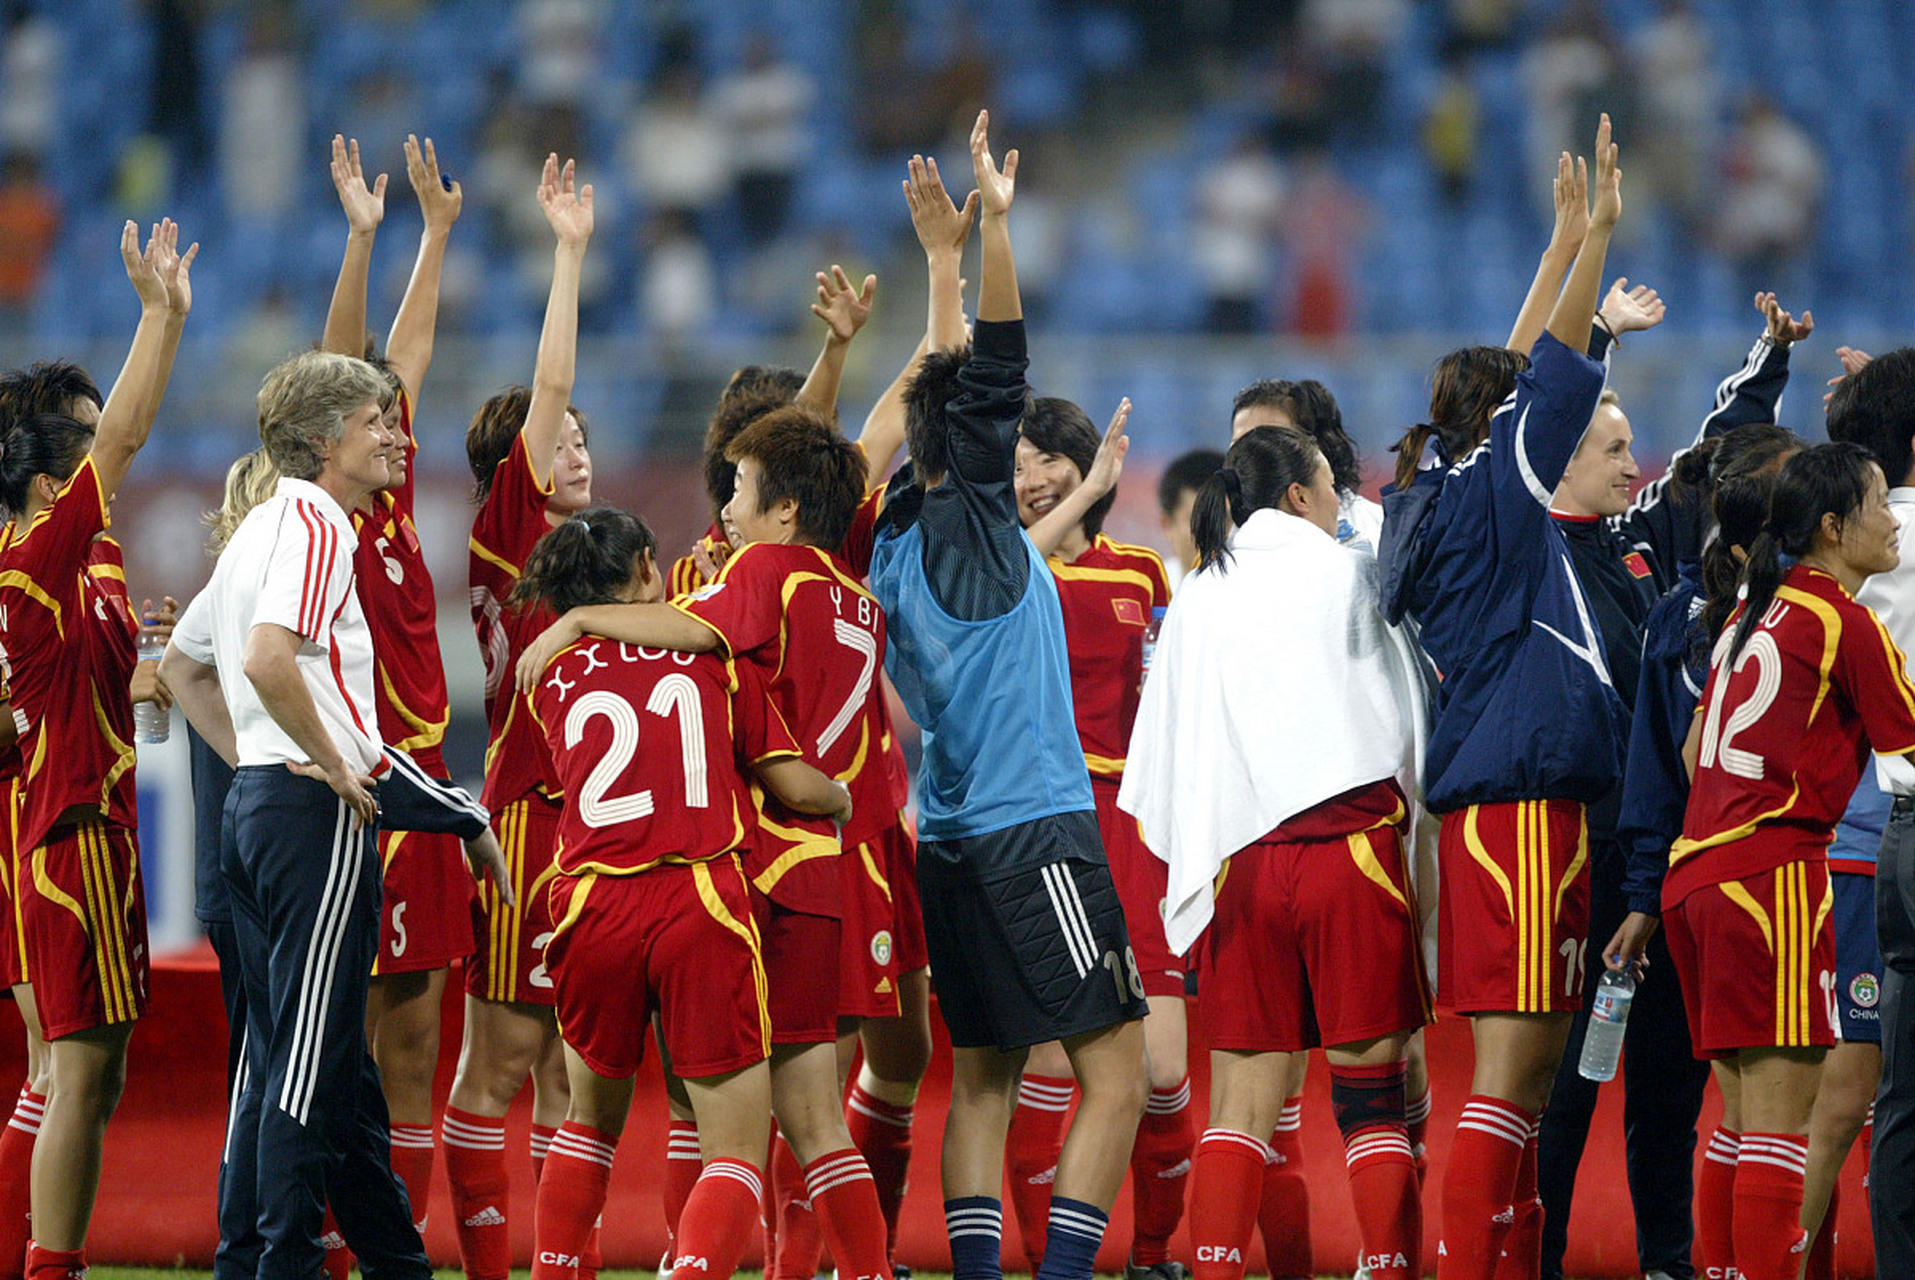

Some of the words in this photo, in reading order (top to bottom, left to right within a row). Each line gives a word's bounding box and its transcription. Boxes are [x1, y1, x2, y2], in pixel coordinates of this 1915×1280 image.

[375, 537, 405, 585] 5
[830, 586, 842, 616] Y
[858, 597, 879, 634] BI
[546, 665, 576, 702] X
[575, 643, 609, 675] X
[816, 618, 878, 759] 7
[1699, 623, 1783, 780] 12
[564, 672, 709, 828] 21
[391, 901, 407, 958] 5
[1104, 945, 1147, 1005] 18
[1849, 1008, 1880, 1020] CHINA
[540, 1250, 578, 1268] CFA
[672, 1255, 707, 1271] CFA
[1197, 1246, 1241, 1263] CFA
[1367, 1252, 1407, 1270] CFA
